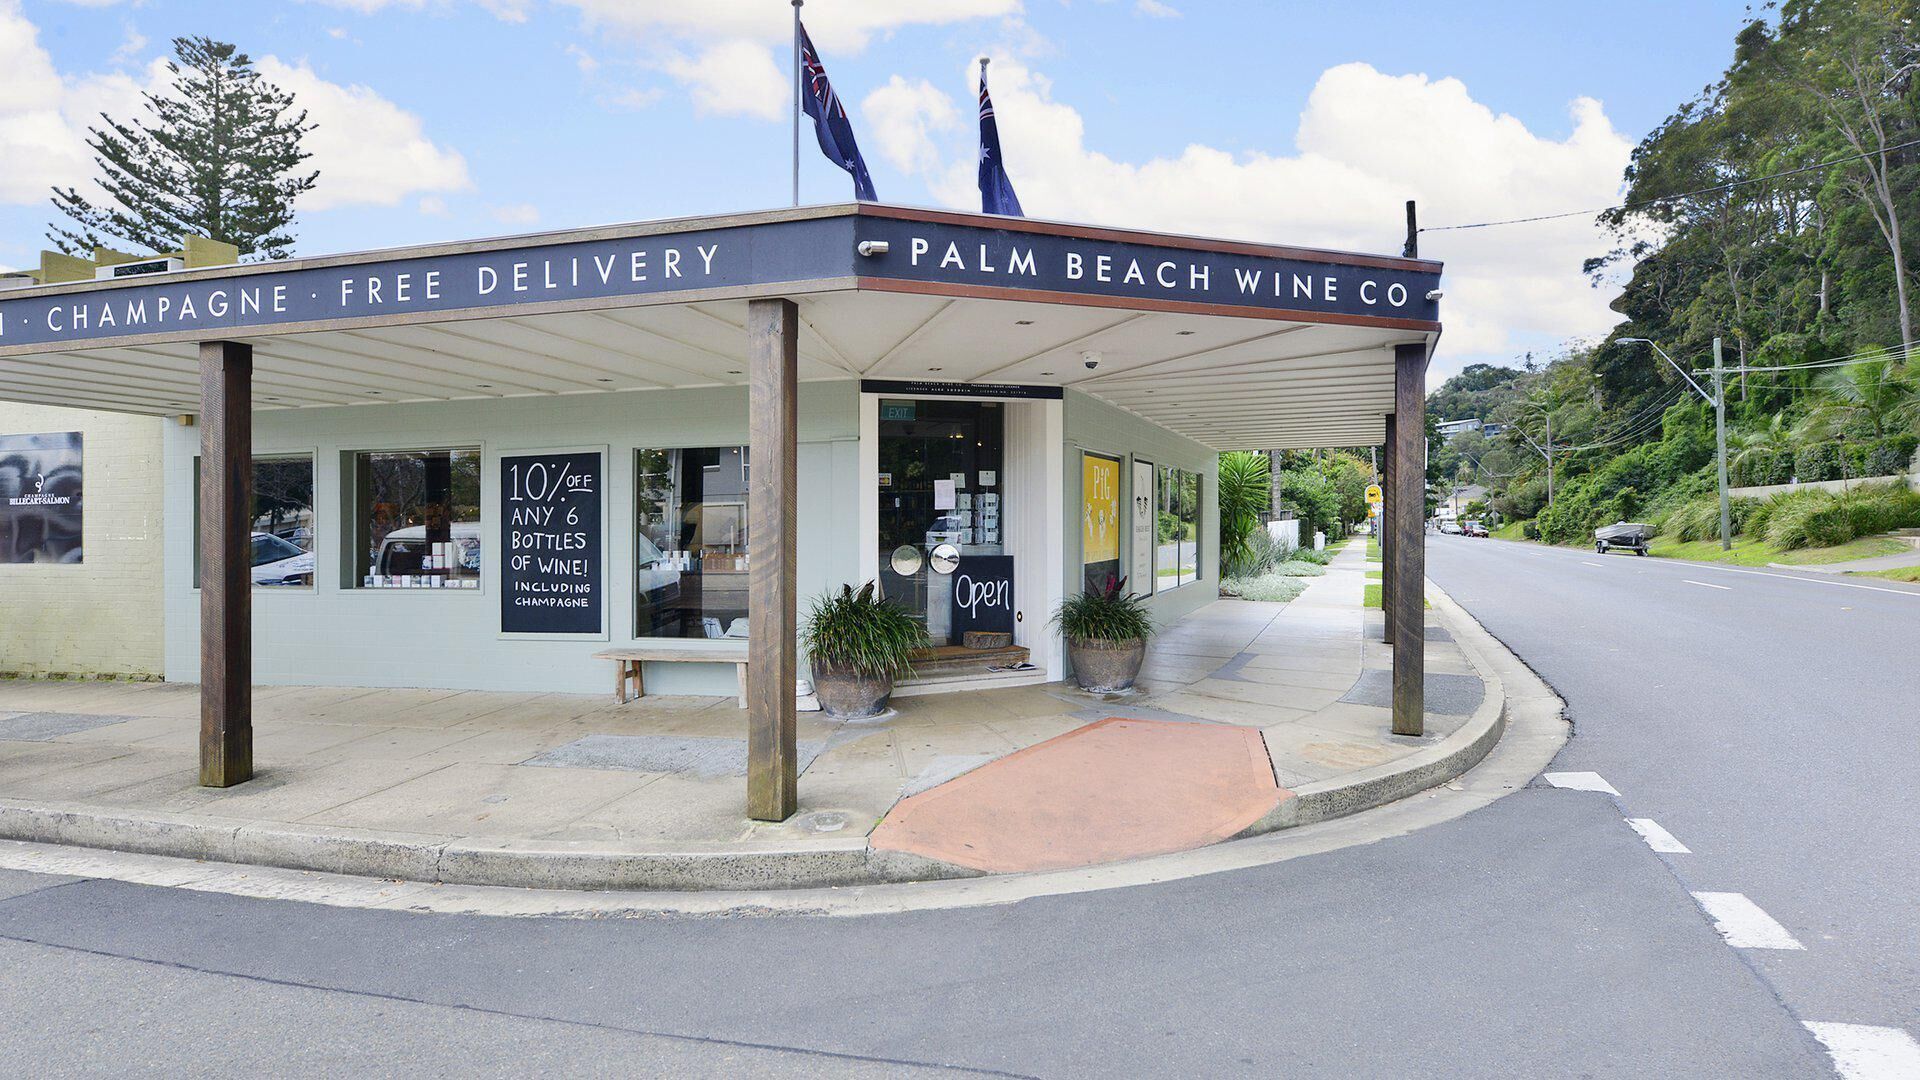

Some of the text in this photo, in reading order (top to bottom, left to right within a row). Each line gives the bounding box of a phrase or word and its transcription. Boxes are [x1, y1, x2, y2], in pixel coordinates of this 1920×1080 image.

[911, 237, 1408, 307] PALM BEACH WINE CO
[47, 285, 287, 332] CHAMPAGNE
[341, 271, 440, 306] FREE
[478, 244, 718, 295] DELIVERY
[888, 407, 908, 418] EXIT
[510, 462, 592, 502] 10% OFF
[9, 497, 70, 505] BILLECART-SALMON
[511, 506, 579, 526] ANY 6
[512, 531, 587, 550] BOTTLES
[511, 555, 588, 577] OF WINE!
[515, 581, 591, 594] INCLUDING
[955, 574, 1010, 619] Open
[515, 597, 589, 608] CHAMPAGNE
